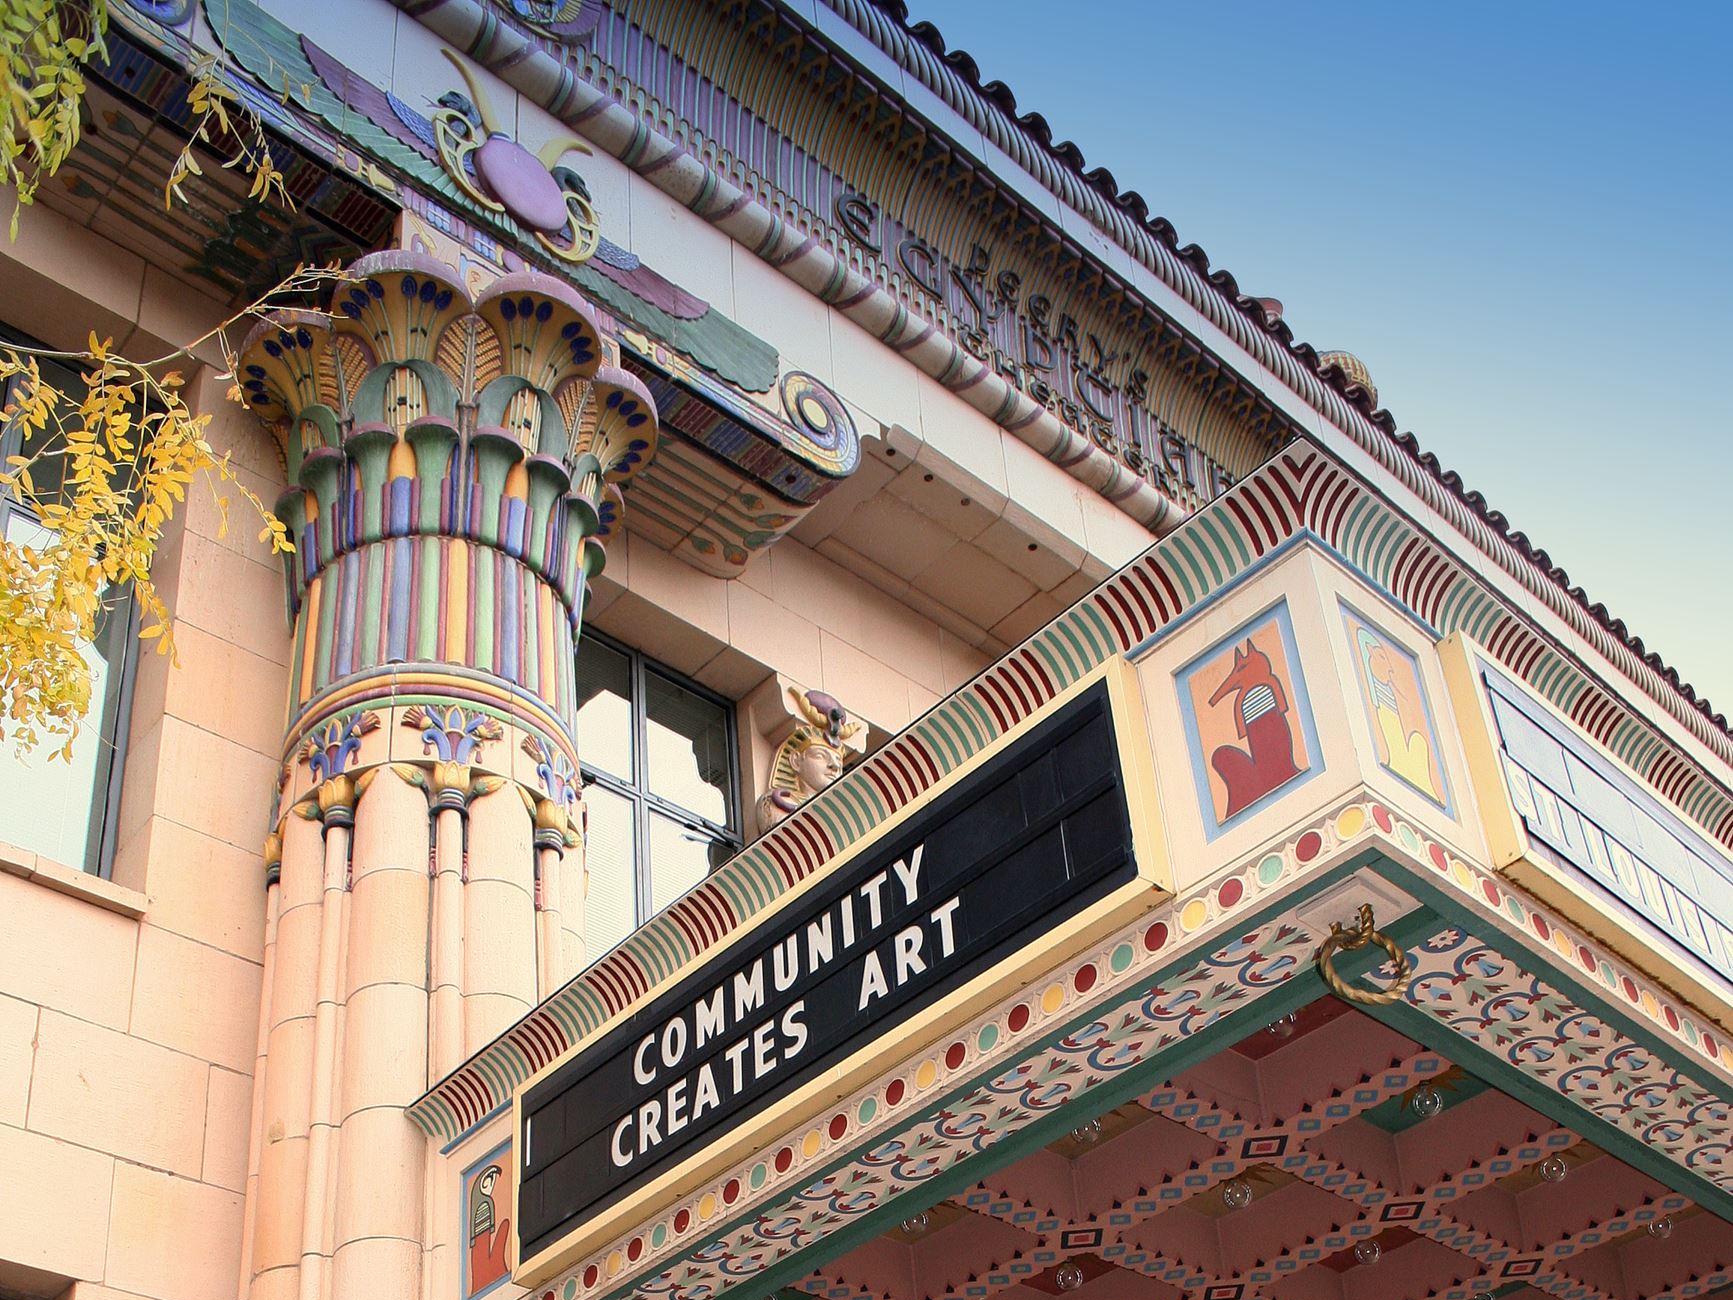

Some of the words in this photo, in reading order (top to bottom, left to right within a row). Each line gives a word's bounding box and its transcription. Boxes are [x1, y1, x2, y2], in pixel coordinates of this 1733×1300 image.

[611, 1000, 809, 1168] CREATES
[857, 896, 960, 1012] ART
[633, 844, 925, 1086] COMMUNITY
